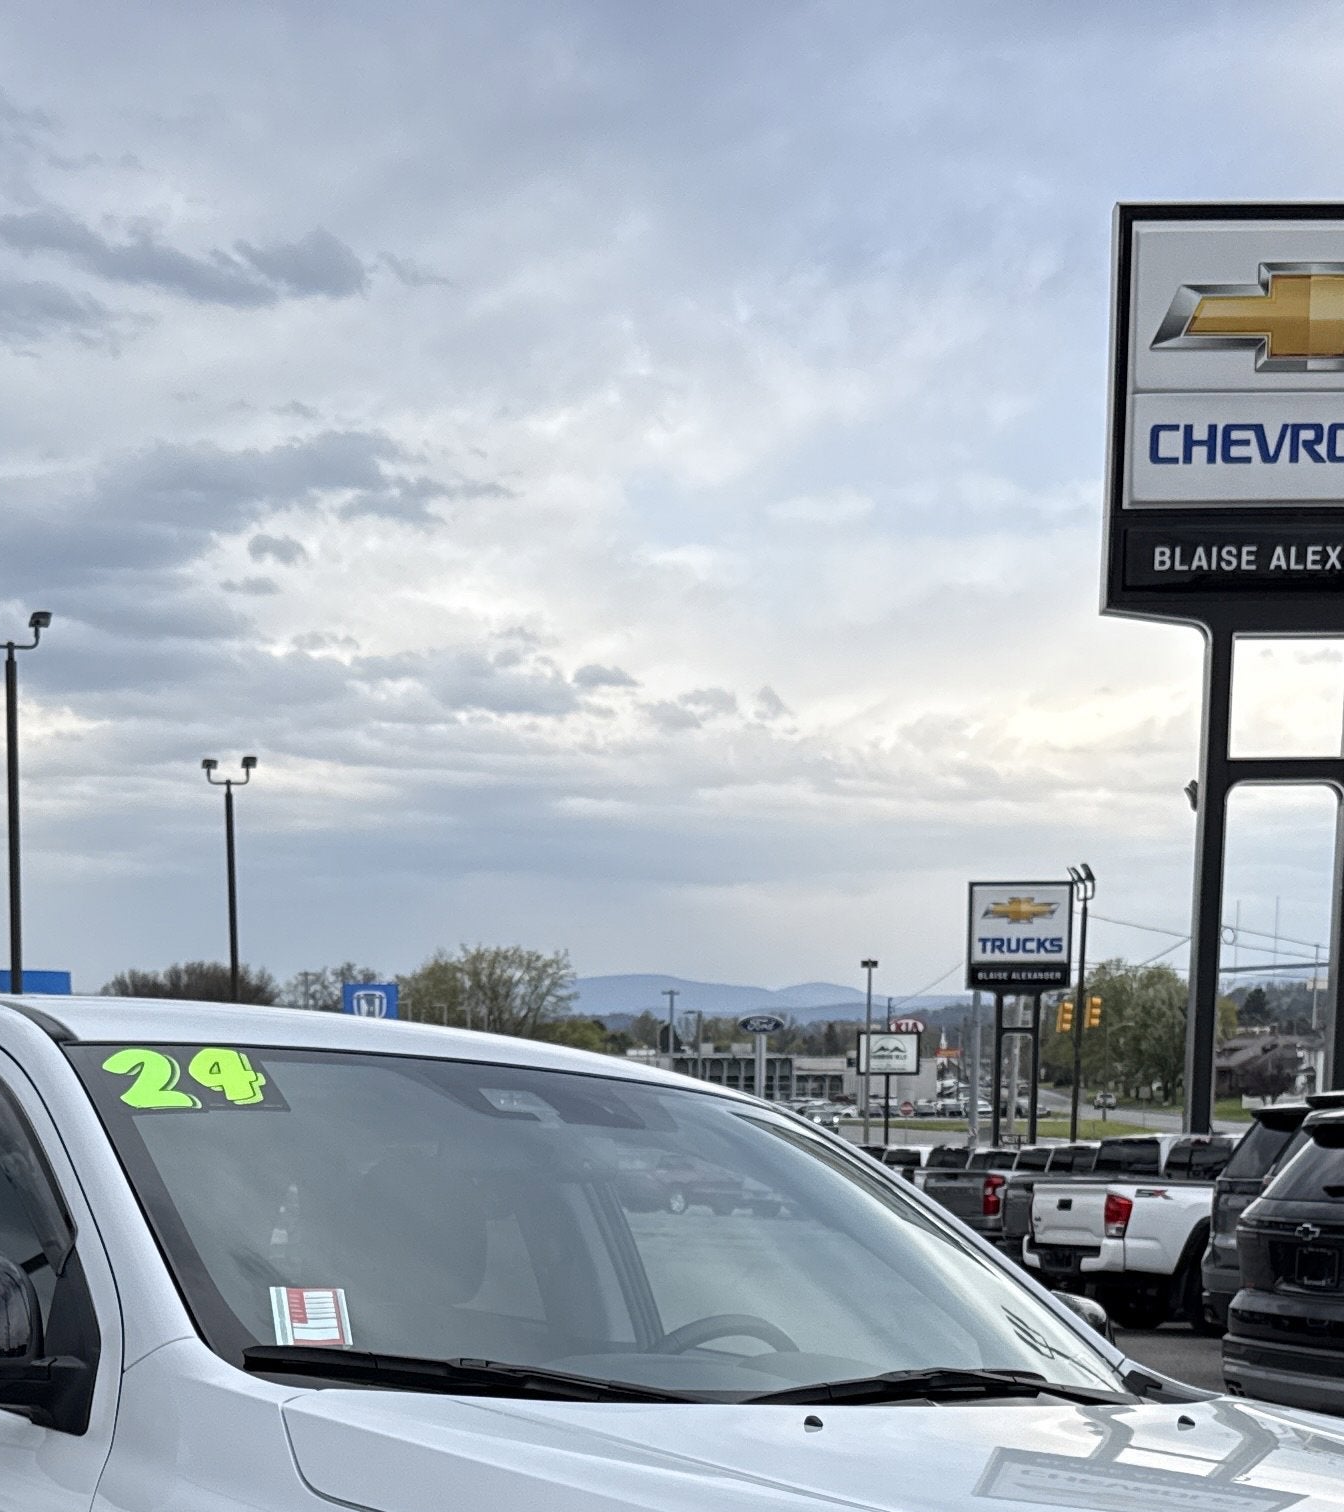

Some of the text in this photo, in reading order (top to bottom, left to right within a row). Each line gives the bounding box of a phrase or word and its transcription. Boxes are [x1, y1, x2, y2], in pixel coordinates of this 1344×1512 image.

[1153, 545, 1258, 571] BLAISE
[977, 937, 1063, 954] TRUCKS
[977, 971, 1062, 981] BLAISE ALEXANDER
[102, 1048, 266, 1109] 24
